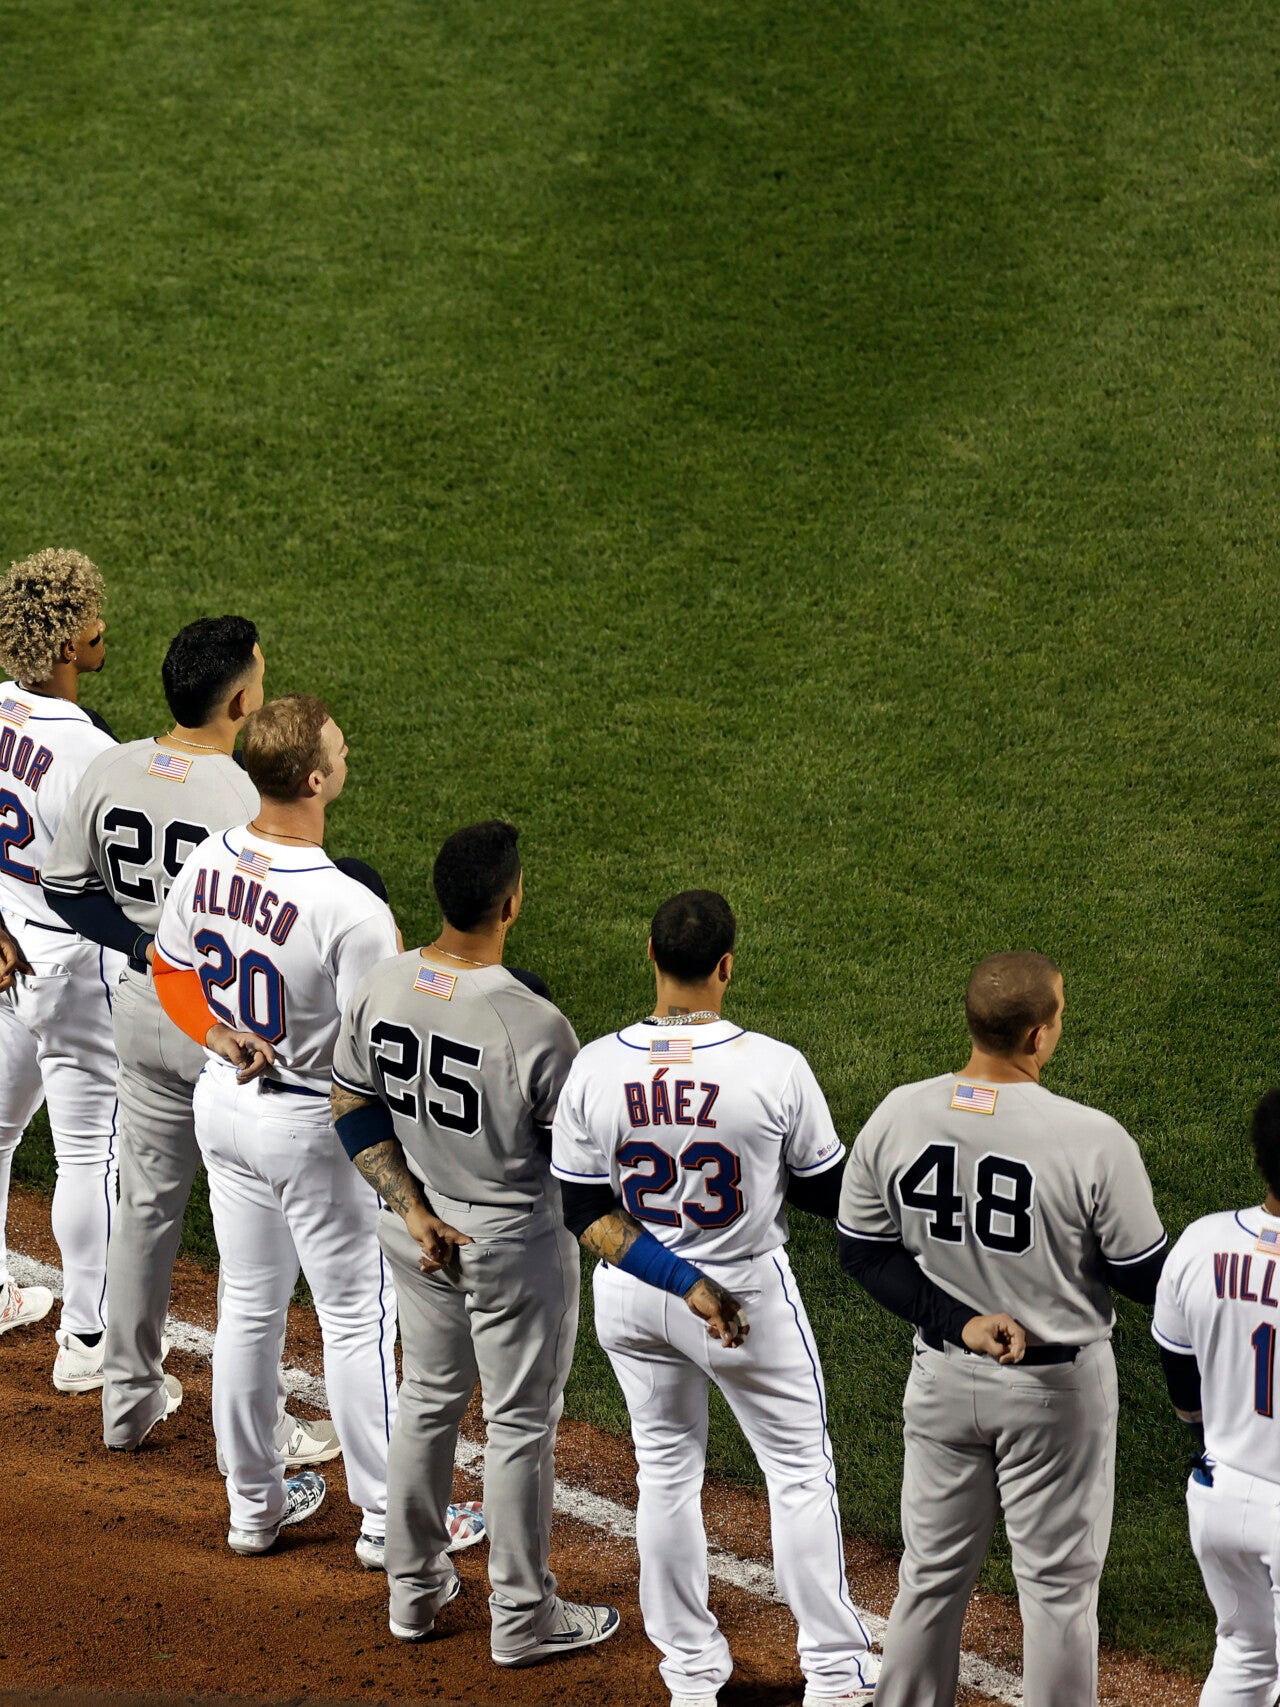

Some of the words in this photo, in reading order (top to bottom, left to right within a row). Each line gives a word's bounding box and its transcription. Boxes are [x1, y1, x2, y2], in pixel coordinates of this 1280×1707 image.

[192, 867, 298, 946] ALONSO
[193, 928, 286, 1045] 20
[368, 1017, 484, 1138] 25
[624, 1067, 719, 1128] BÁEZ
[617, 1141, 743, 1230] 23
[895, 1141, 1036, 1256] 48
[1214, 1253, 1278, 1308] VILL
[1251, 1321, 1276, 1419] 1
